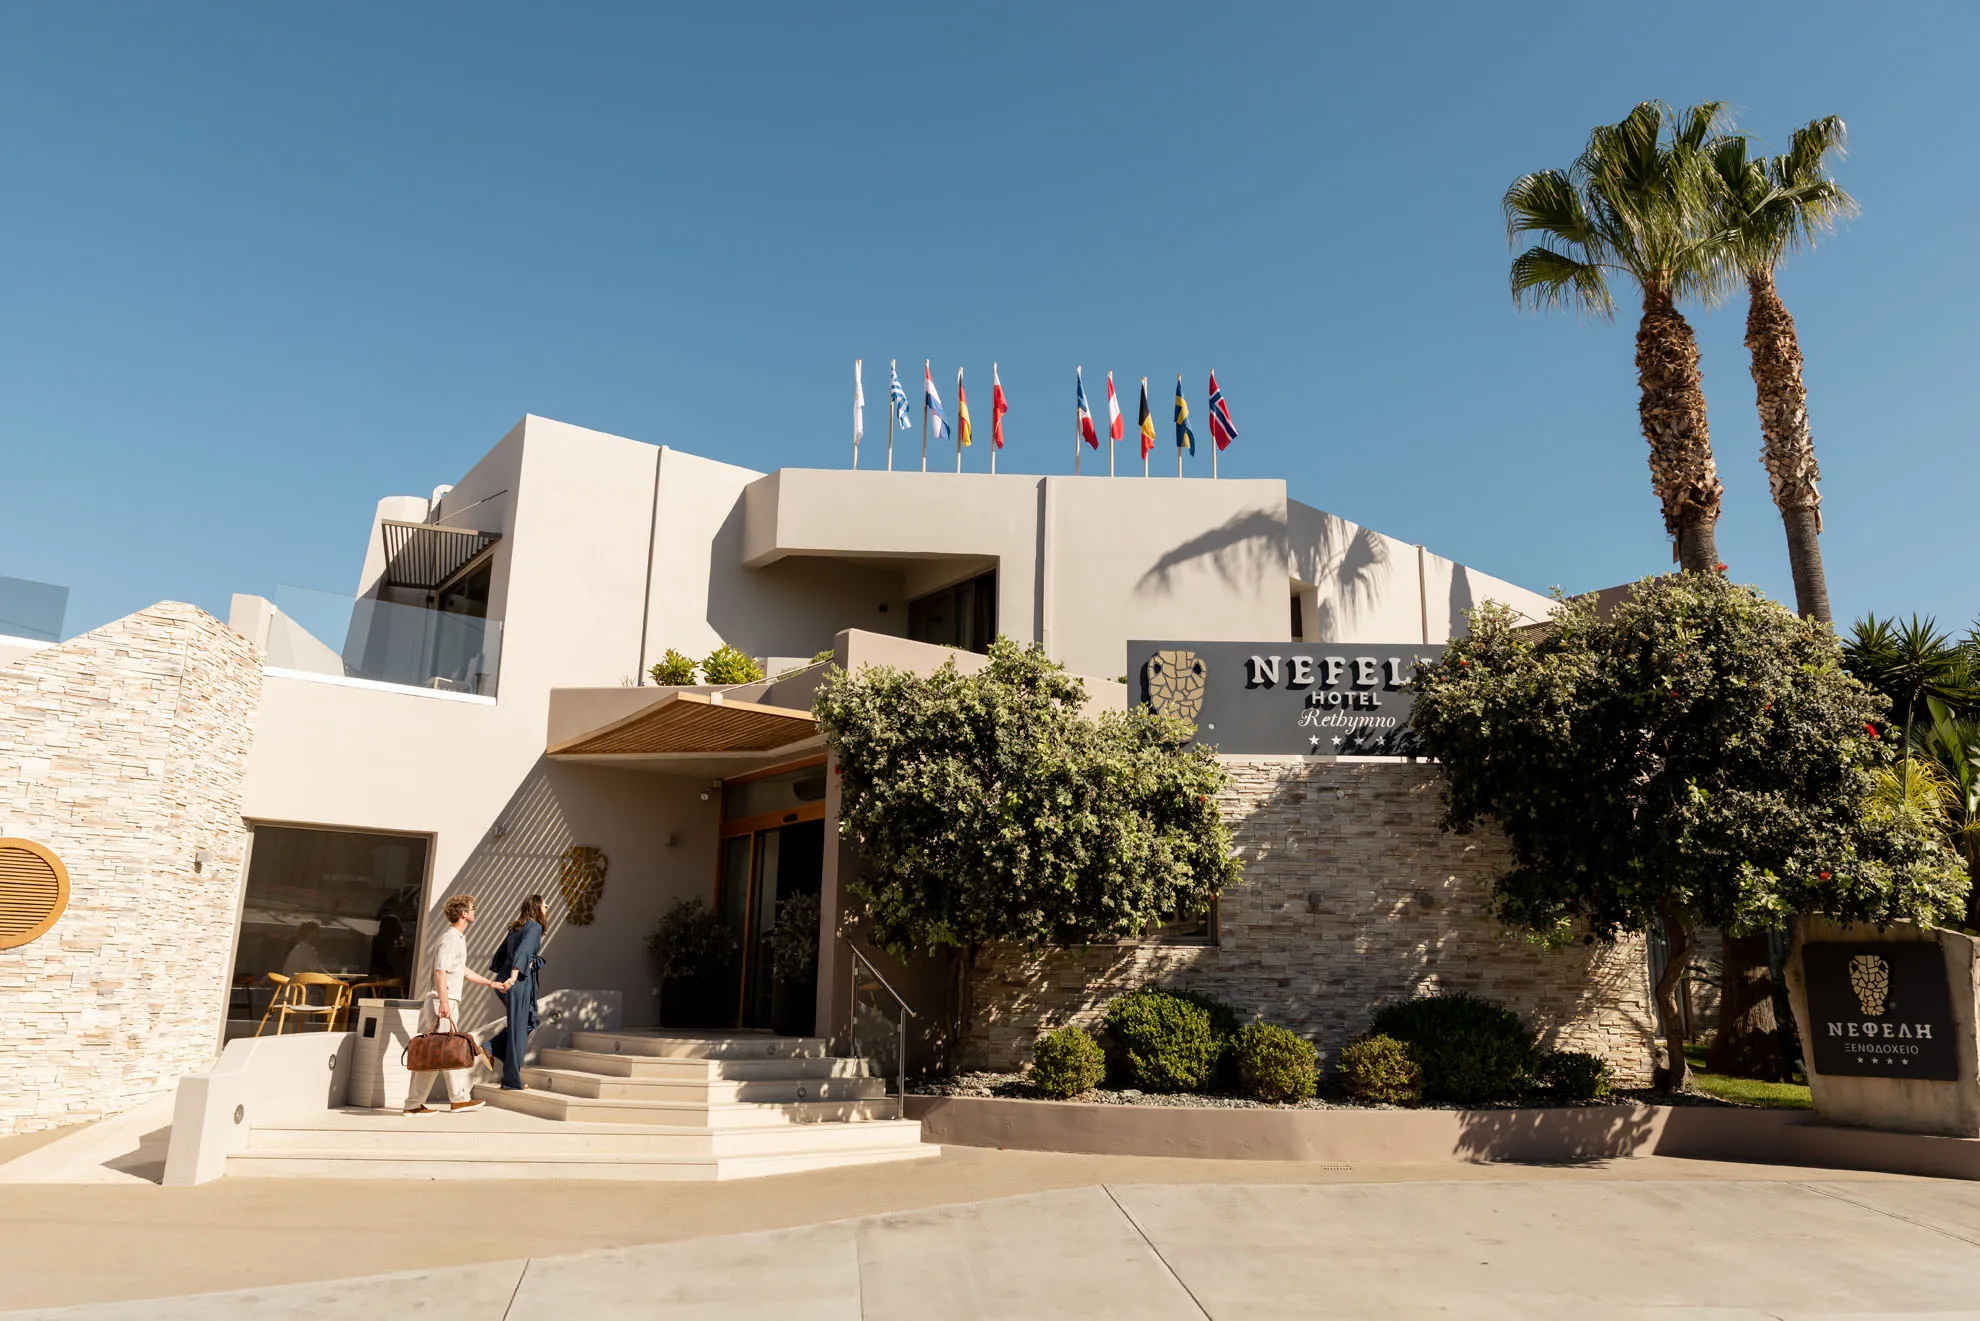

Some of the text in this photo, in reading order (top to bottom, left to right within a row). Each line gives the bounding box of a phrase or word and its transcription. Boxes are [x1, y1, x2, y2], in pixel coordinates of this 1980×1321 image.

[1250, 655, 1433, 686] NEFEL
[1311, 691, 1382, 705] HOTEL
[1297, 707, 1396, 735] Rethymno
[1827, 1022, 1933, 1039] ΝΕΦΕΛΗ
[1844, 1043, 1919, 1055] ΞΕΝΟΔΟΧΕΙΟ
